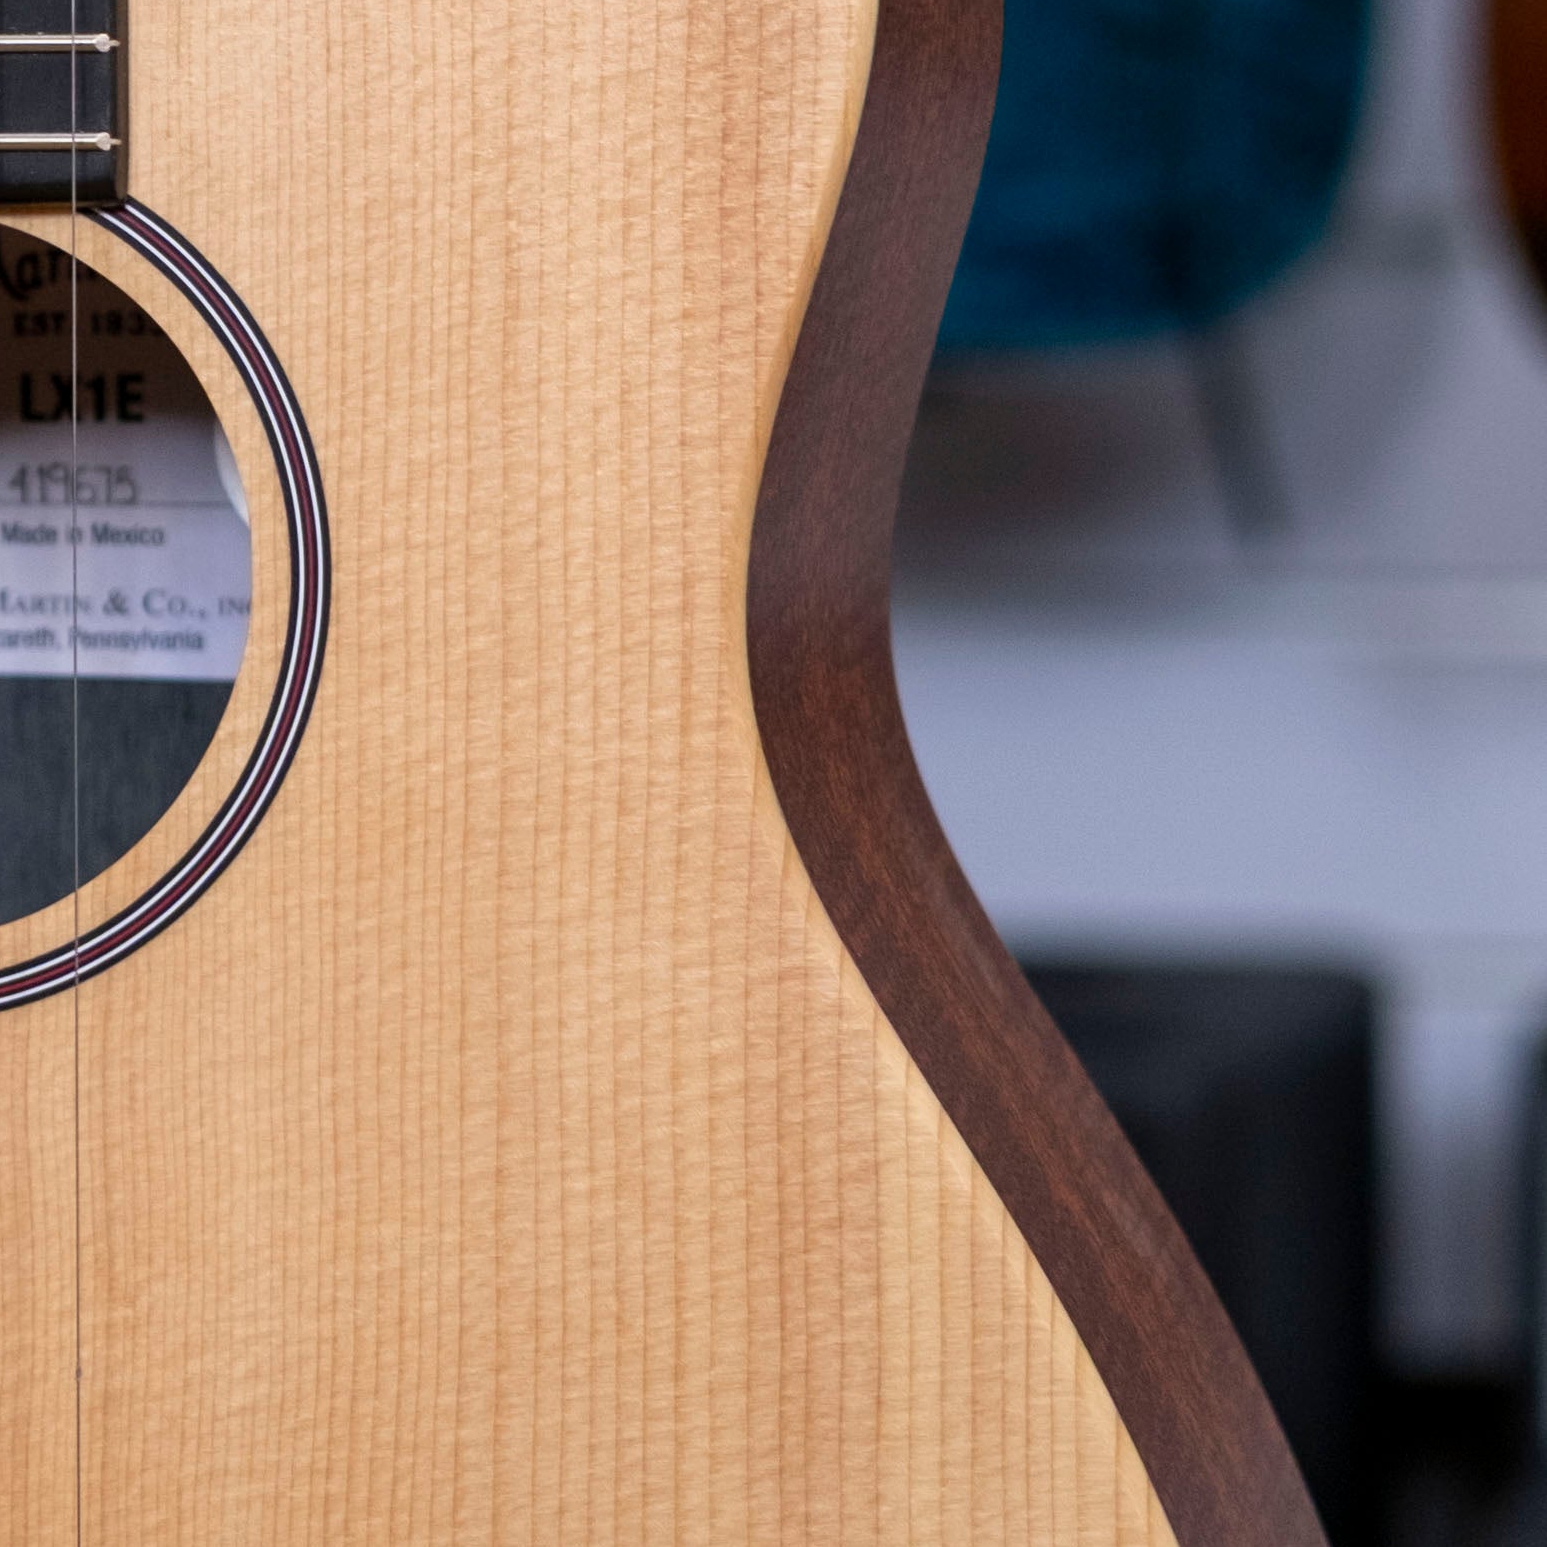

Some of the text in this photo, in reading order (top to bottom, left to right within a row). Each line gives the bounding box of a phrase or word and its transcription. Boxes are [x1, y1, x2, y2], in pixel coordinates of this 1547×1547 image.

[20, 372, 145, 423] LX1E
[0, 521, 58, 545] Made
[90, 522, 167, 547] Mexico
[101, 587, 129, 617] &
